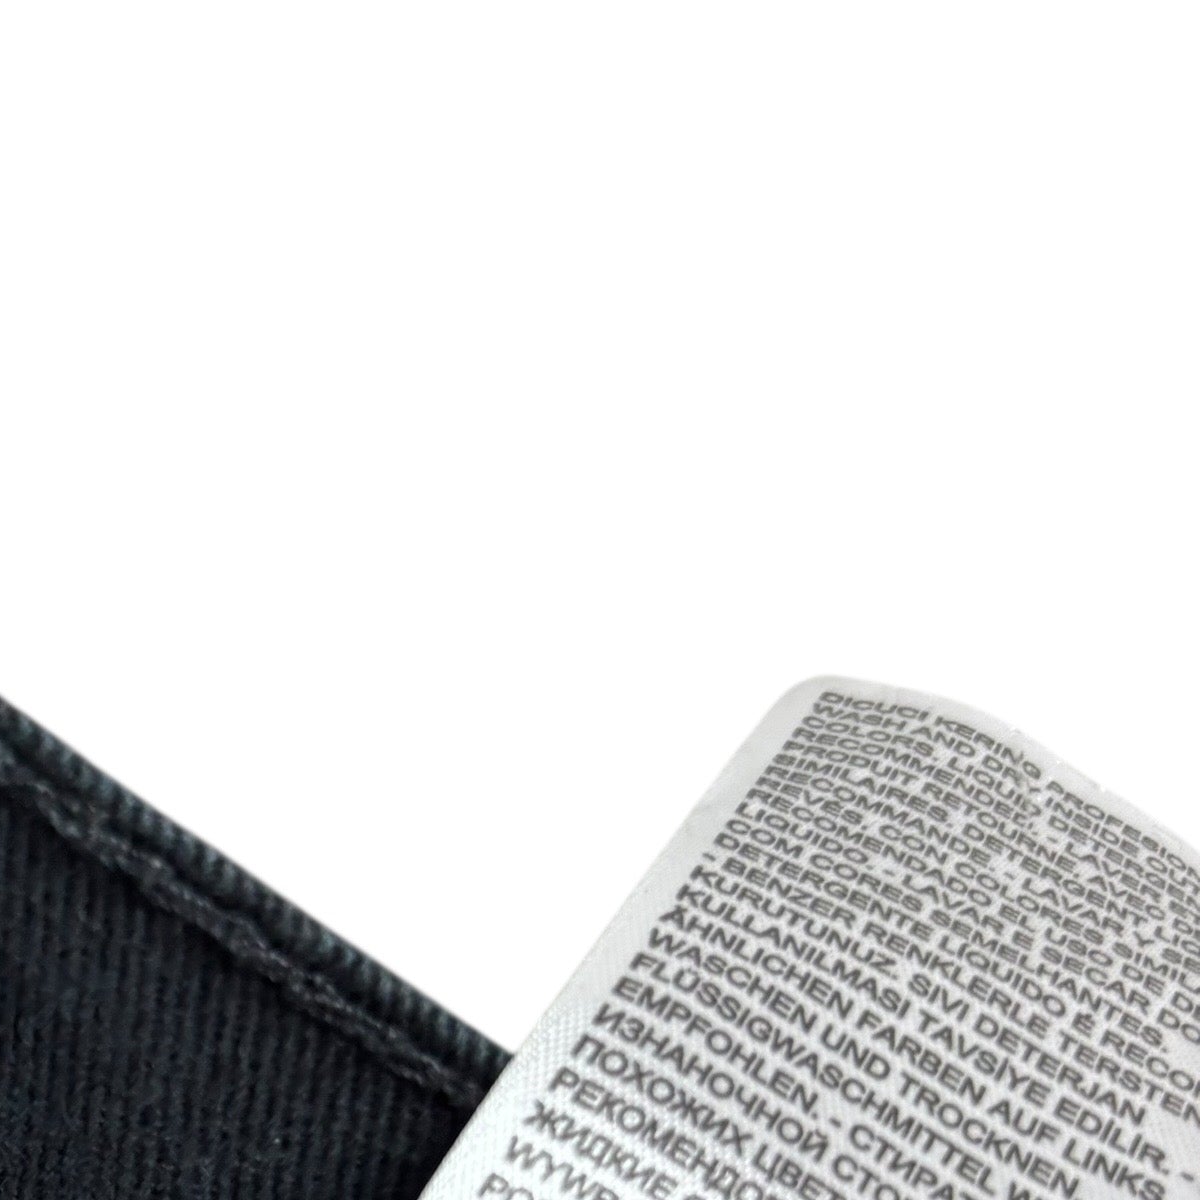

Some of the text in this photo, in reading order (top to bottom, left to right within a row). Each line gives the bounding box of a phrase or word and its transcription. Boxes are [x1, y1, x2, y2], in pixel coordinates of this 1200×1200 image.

[811, 700, 906, 732] WASH
[913, 725, 974, 758] AND
[1046, 798, 1136, 855] INSIDE
[936, 716, 1040, 779] KERING
[715, 831, 932, 941] DETERGENTE
[748, 788, 1168, 998] RECOMENDADO EL USO DE
[784, 739, 1164, 920] PRODUIT AVEC
[879, 823, 946, 863] CON
[955, 861, 1104, 944] COLORES
[963, 824, 1146, 928] DETERGENT
[1066, 843, 1160, 902] LAVER
[676, 883, 910, 1018] KULLANILMASI
[723, 856, 854, 926] BENZER
[863, 922, 1051, 1038] RENKLERLE
[726, 818, 801, 857] COM
[810, 853, 922, 912] CORES
[930, 910, 1170, 1052] SEMELHANTES.
[902, 874, 1002, 933] LAVAR
[1009, 929, 1036, 952] E
[1041, 947, 1151, 1013] SECAR
[1024, 878, 1124, 935] LAVAR
[1128, 930, 1155, 951] Y
[613, 974, 825, 1118] EMPFOHLEN.
[646, 928, 816, 1033] WASCHEN
[819, 1024, 892, 1082] UND
[660, 903, 854, 1019] ÄHNLICHEN
[856, 1009, 985, 1104] FARBEN
[989, 1096, 1059, 1149] AUF
[691, 864, 1145, 1124] KURUTUNUZ. SIVI DETERJAN
[572, 1033, 751, 1156] ПОХОЖИХ
[594, 1003, 830, 1162] ИЗНАНОЧНОЙ
[630, 950, 1001, 1195] FLÜSSIGWASCHMITTEL
